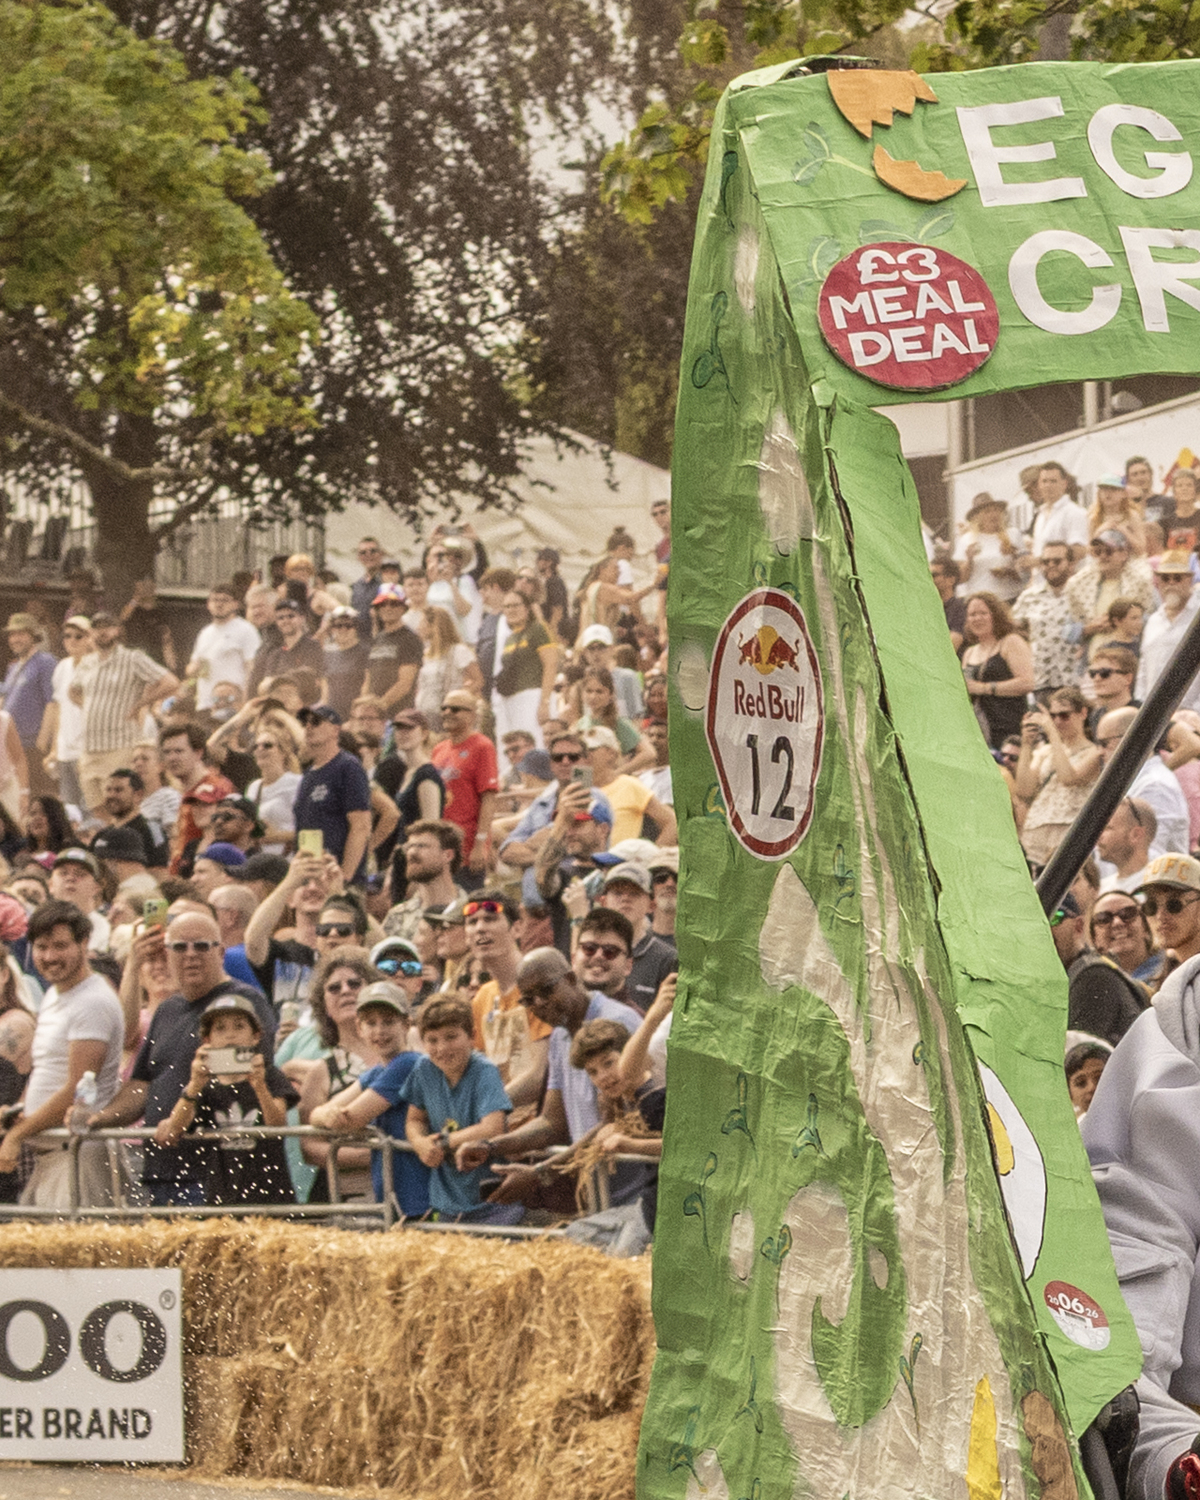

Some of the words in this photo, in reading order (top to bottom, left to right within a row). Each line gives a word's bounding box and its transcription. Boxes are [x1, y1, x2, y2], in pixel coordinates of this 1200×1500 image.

[857, 247, 942, 285] £3
[828, 280, 986, 330] MEAL
[847, 318, 991, 367] DEAL
[733, 679, 767, 718] Red
[767, 684, 805, 723] Bull
[746, 733, 795, 821] 12
[1058, 1292, 1085, 1314] 06
[44, 1407, 152, 1439] BRAND
